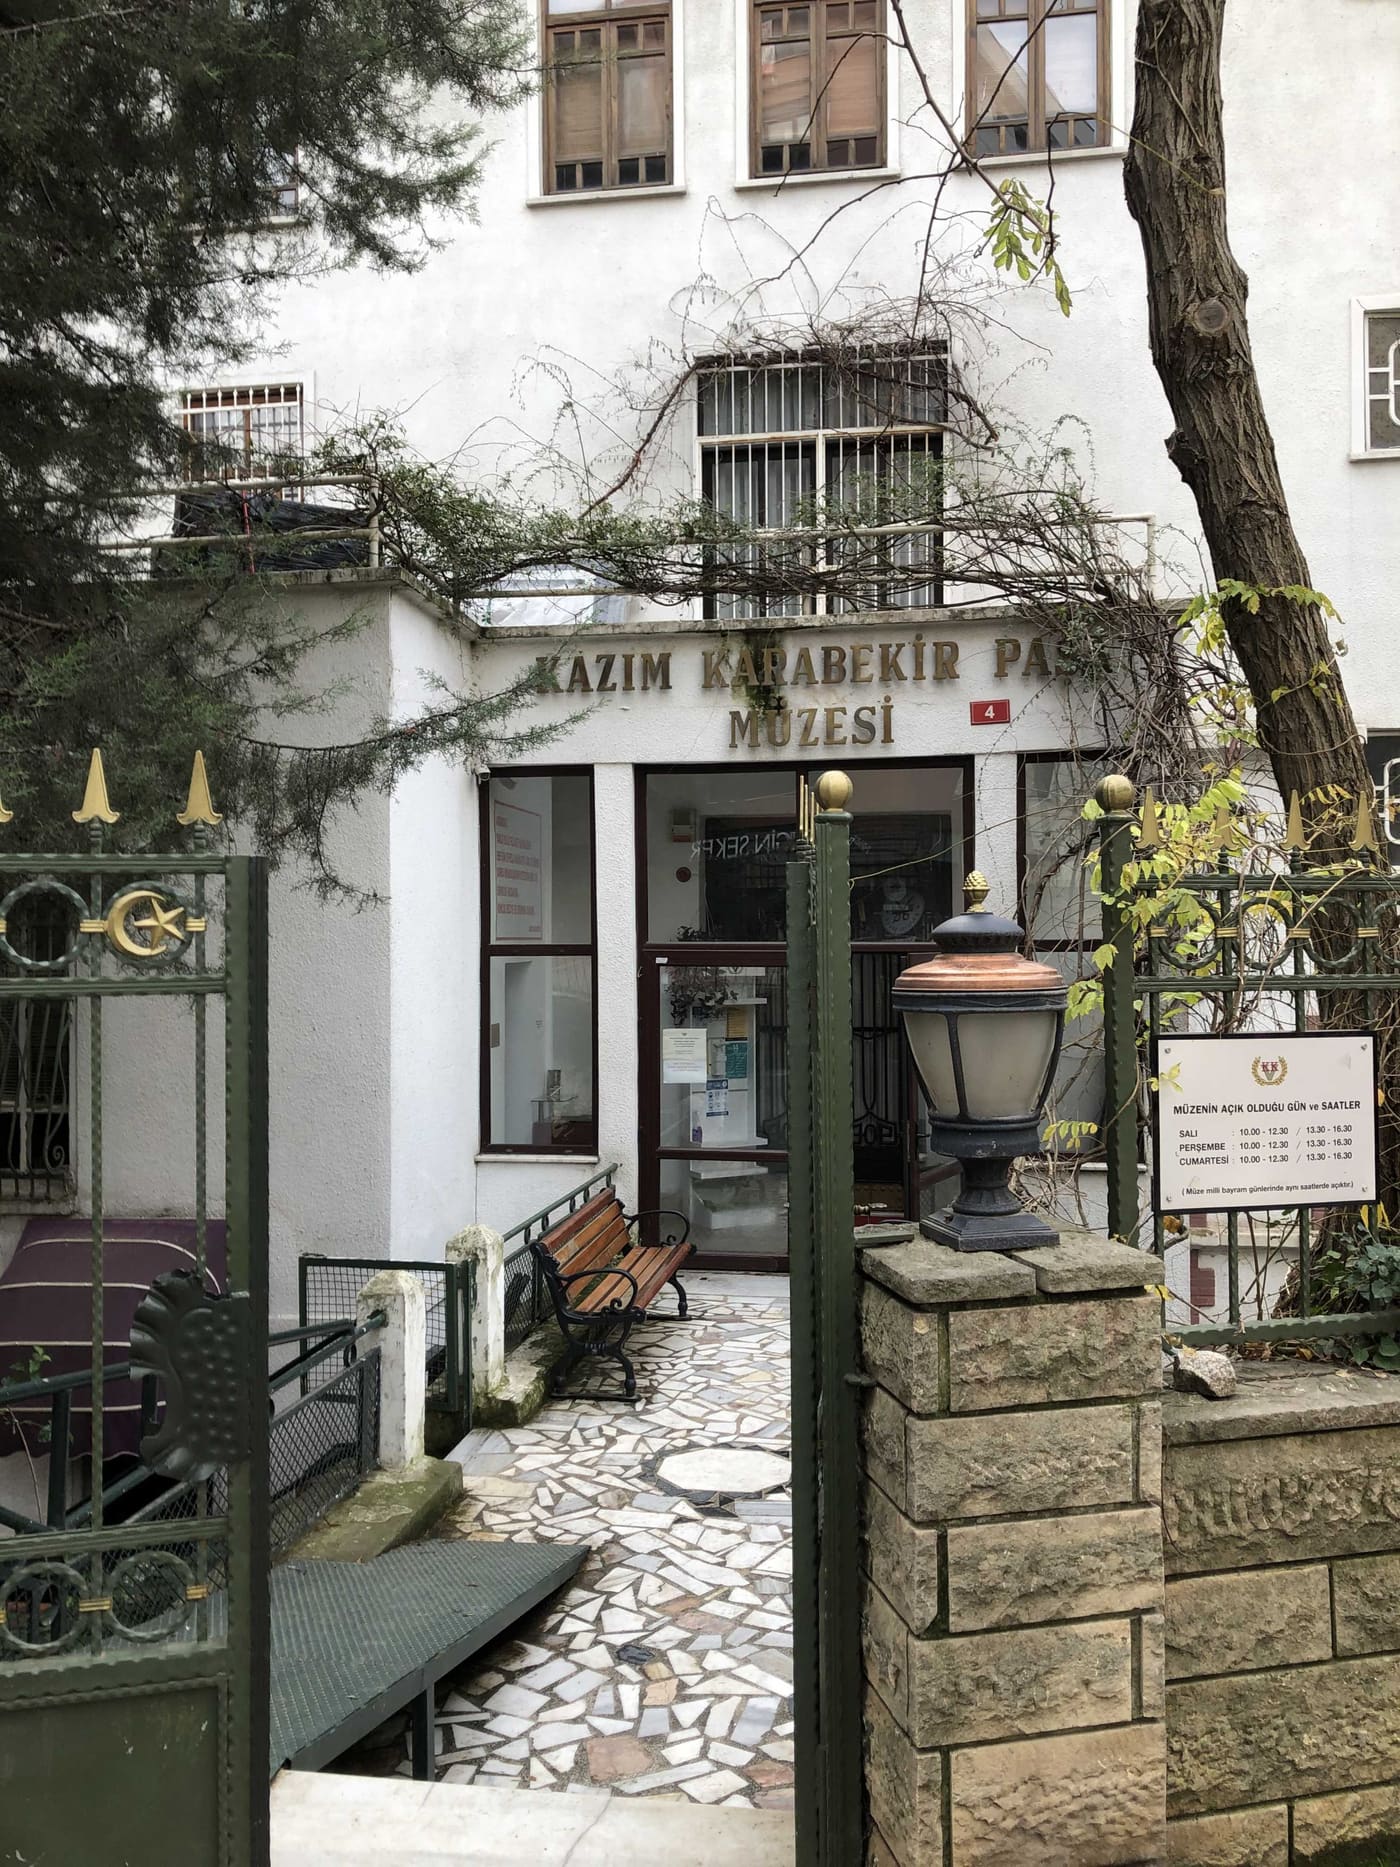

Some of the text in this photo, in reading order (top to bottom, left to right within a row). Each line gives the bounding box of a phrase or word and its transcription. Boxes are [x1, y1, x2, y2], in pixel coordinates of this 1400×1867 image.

[702, 633, 960, 689] KARABEKİR
[984, 704, 996, 719] 4
[1174, 1103, 1218, 1115] MÜZENİN
[1221, 1104, 1244, 1116] AÇIK
[1247, 1101, 1284, 1112] OLDUĞU
[1287, 1100, 1306, 1111] GÜN
[1322, 1101, 1360, 1110] SAATLER
[1179, 1130, 1197, 1138] SALI
[1240, 1128, 1260, 1136] 10.00
[1268, 1127, 1288, 1135] 12.30
[1306, 1126, 1325, 1134] 13.30
[1179, 1142, 1226, 1153] PERŞEMBE
[1268, 1141, 1288, 1149] 12.30
[1307, 1139, 1325, 1148] 13.30
[1333, 1138, 1352, 1146] 16.30
[1179, 1155, 1229, 1166] CUMARTESİ
[1306, 1153, 1326, 1161] 13.30
[1249, 1185, 1284, 1194] günlerinde
